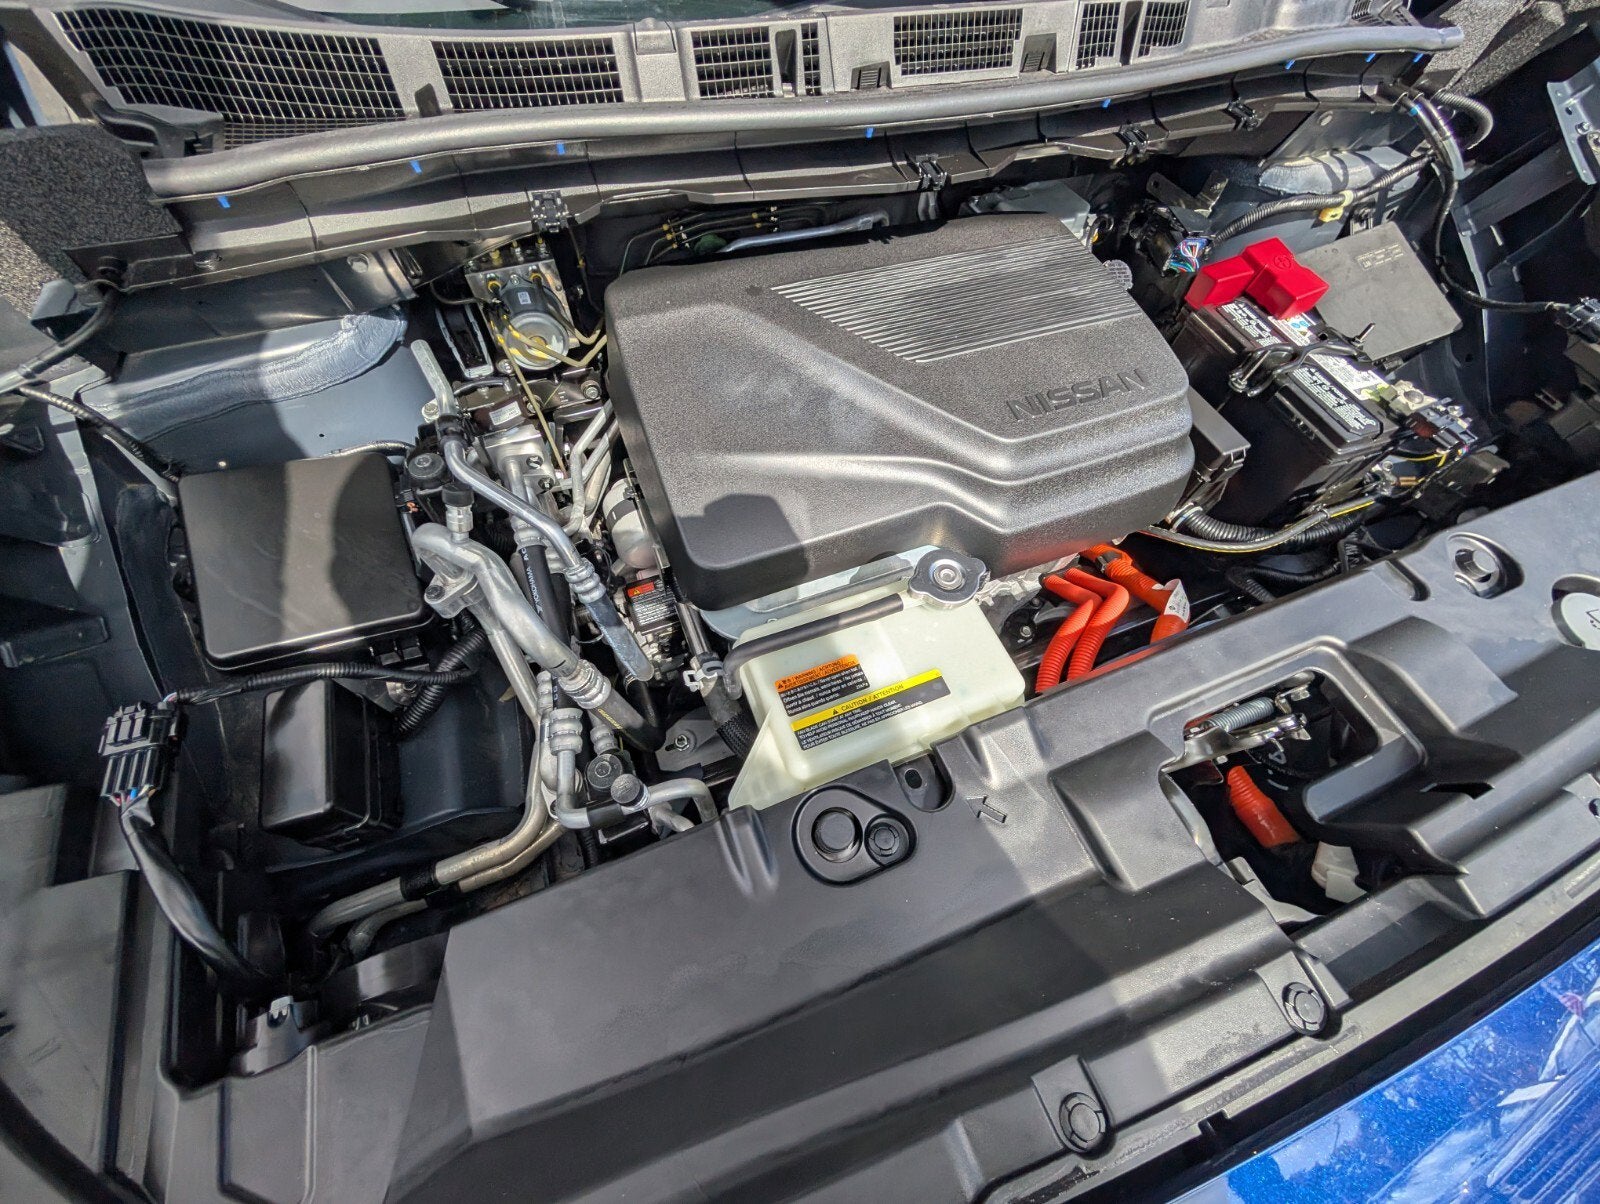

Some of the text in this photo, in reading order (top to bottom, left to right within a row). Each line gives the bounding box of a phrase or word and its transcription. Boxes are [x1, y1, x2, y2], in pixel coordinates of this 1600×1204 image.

[1006, 369, 1150, 422] NISSAN
[841, 698, 867, 712] CAUTION
[873, 685, 904, 699] ATTENTION
